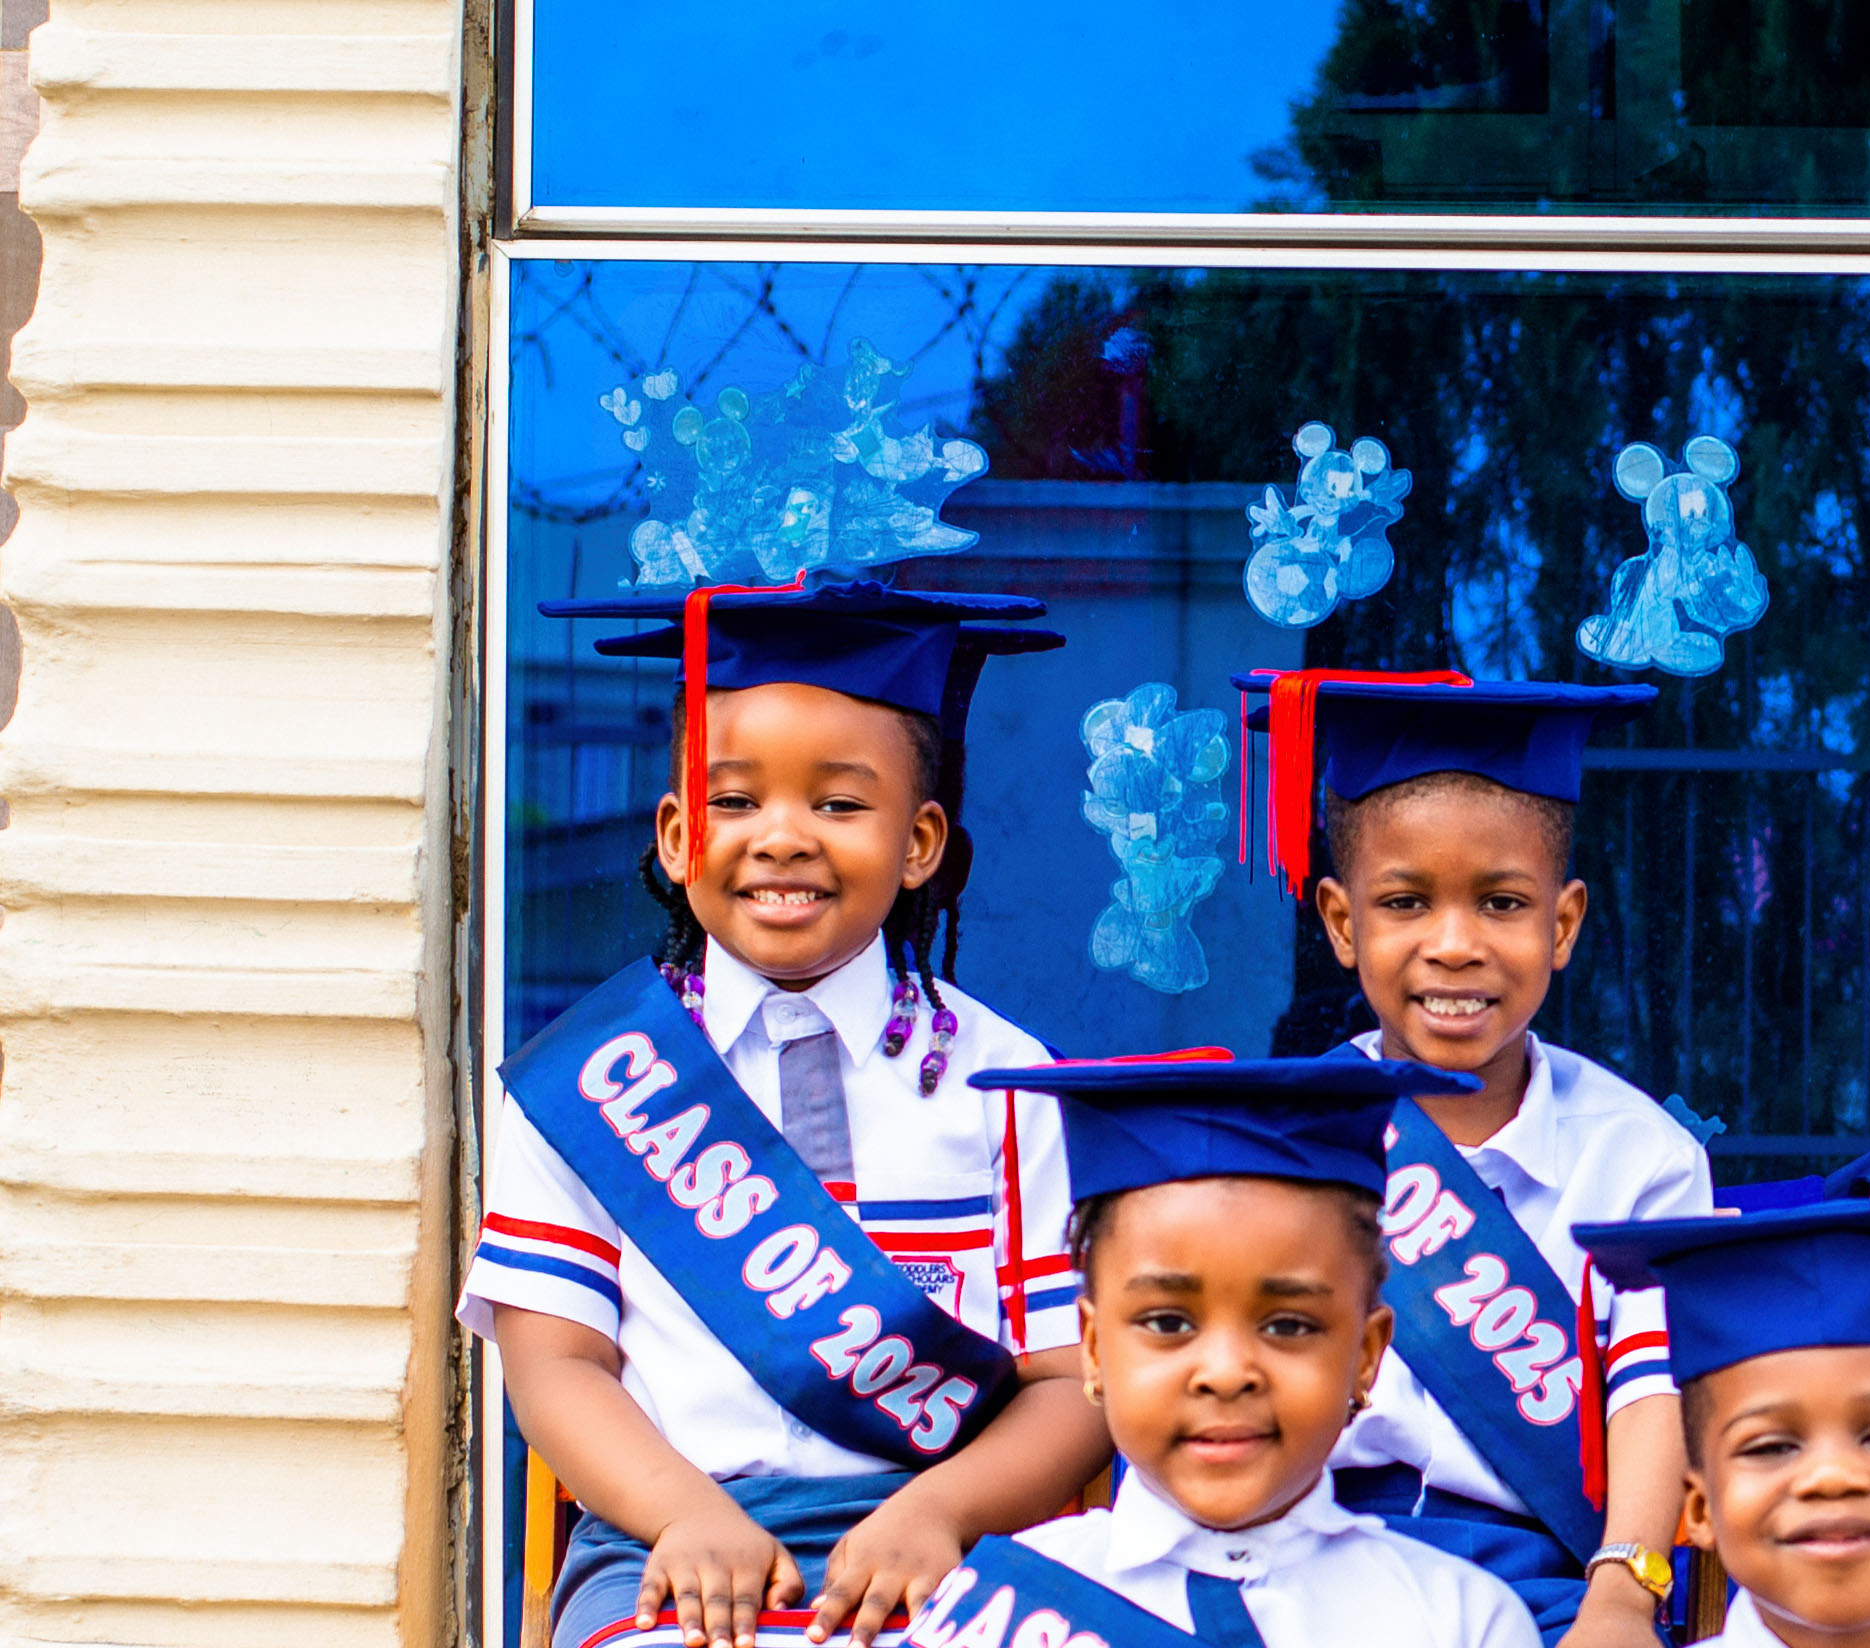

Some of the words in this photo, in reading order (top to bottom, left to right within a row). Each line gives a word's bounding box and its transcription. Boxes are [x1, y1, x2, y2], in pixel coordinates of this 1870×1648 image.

[578, 1032, 779, 1239] CLASS
[742, 1224, 852, 1319] OF
[810, 1304, 978, 1453] 2025
[899, 1264, 946, 1274] ODDLERS
[909, 1274, 955, 1284] HOLARS
[1377, 1162, 1476, 1266] OF
[1434, 1252, 1584, 1426] 2025
